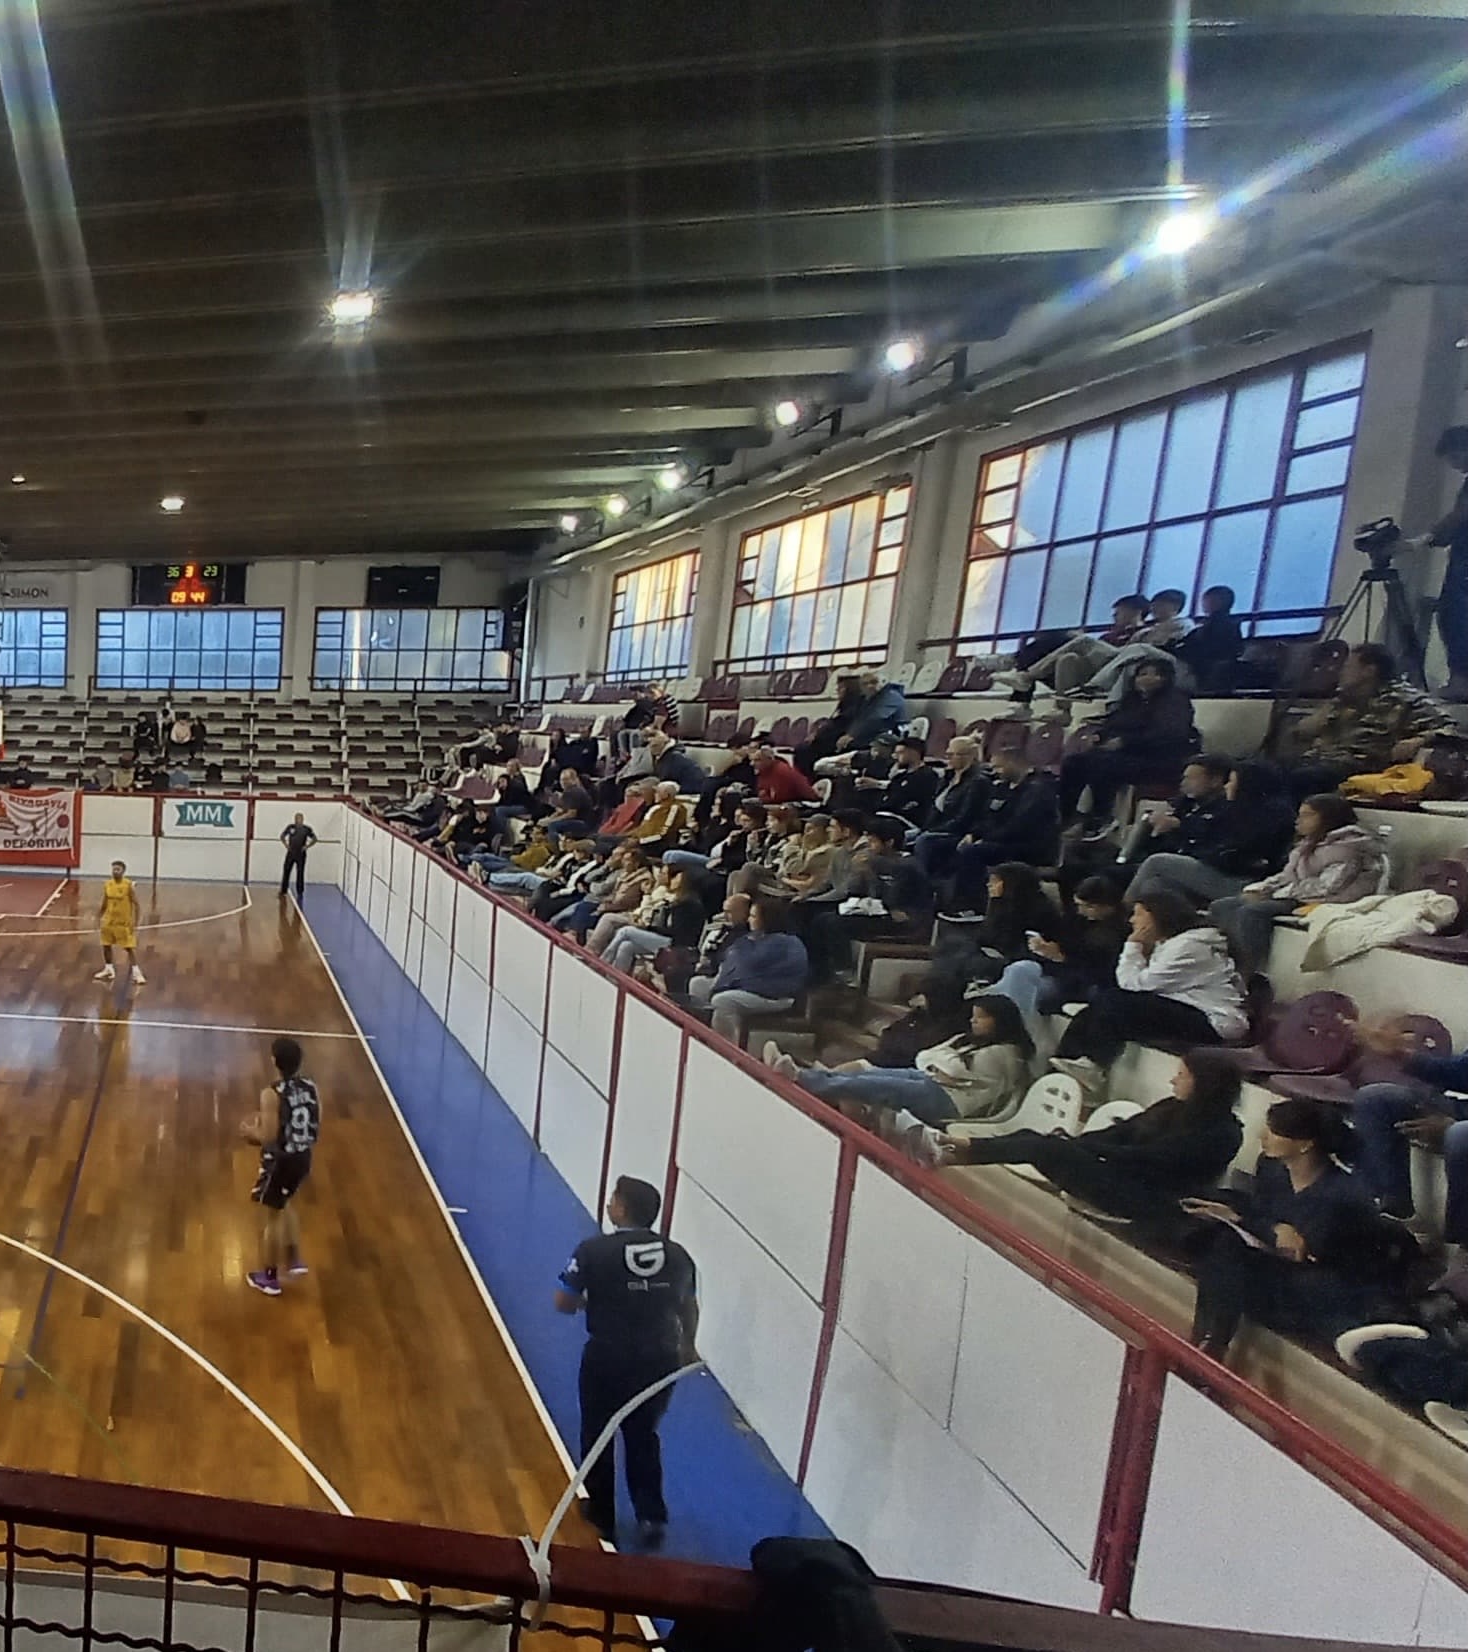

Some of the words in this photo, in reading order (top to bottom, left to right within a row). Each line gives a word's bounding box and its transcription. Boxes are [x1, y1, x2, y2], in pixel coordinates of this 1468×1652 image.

[167, 566, 180, 578] 36
[185, 565, 194, 578] 3
[203, 565, 218, 577] 23
[171, 591, 186, 603] 09
[190, 591, 206, 603] 44
[185, 804, 222, 822] MM
[3, 836, 70, 849] DEPORTIVA
